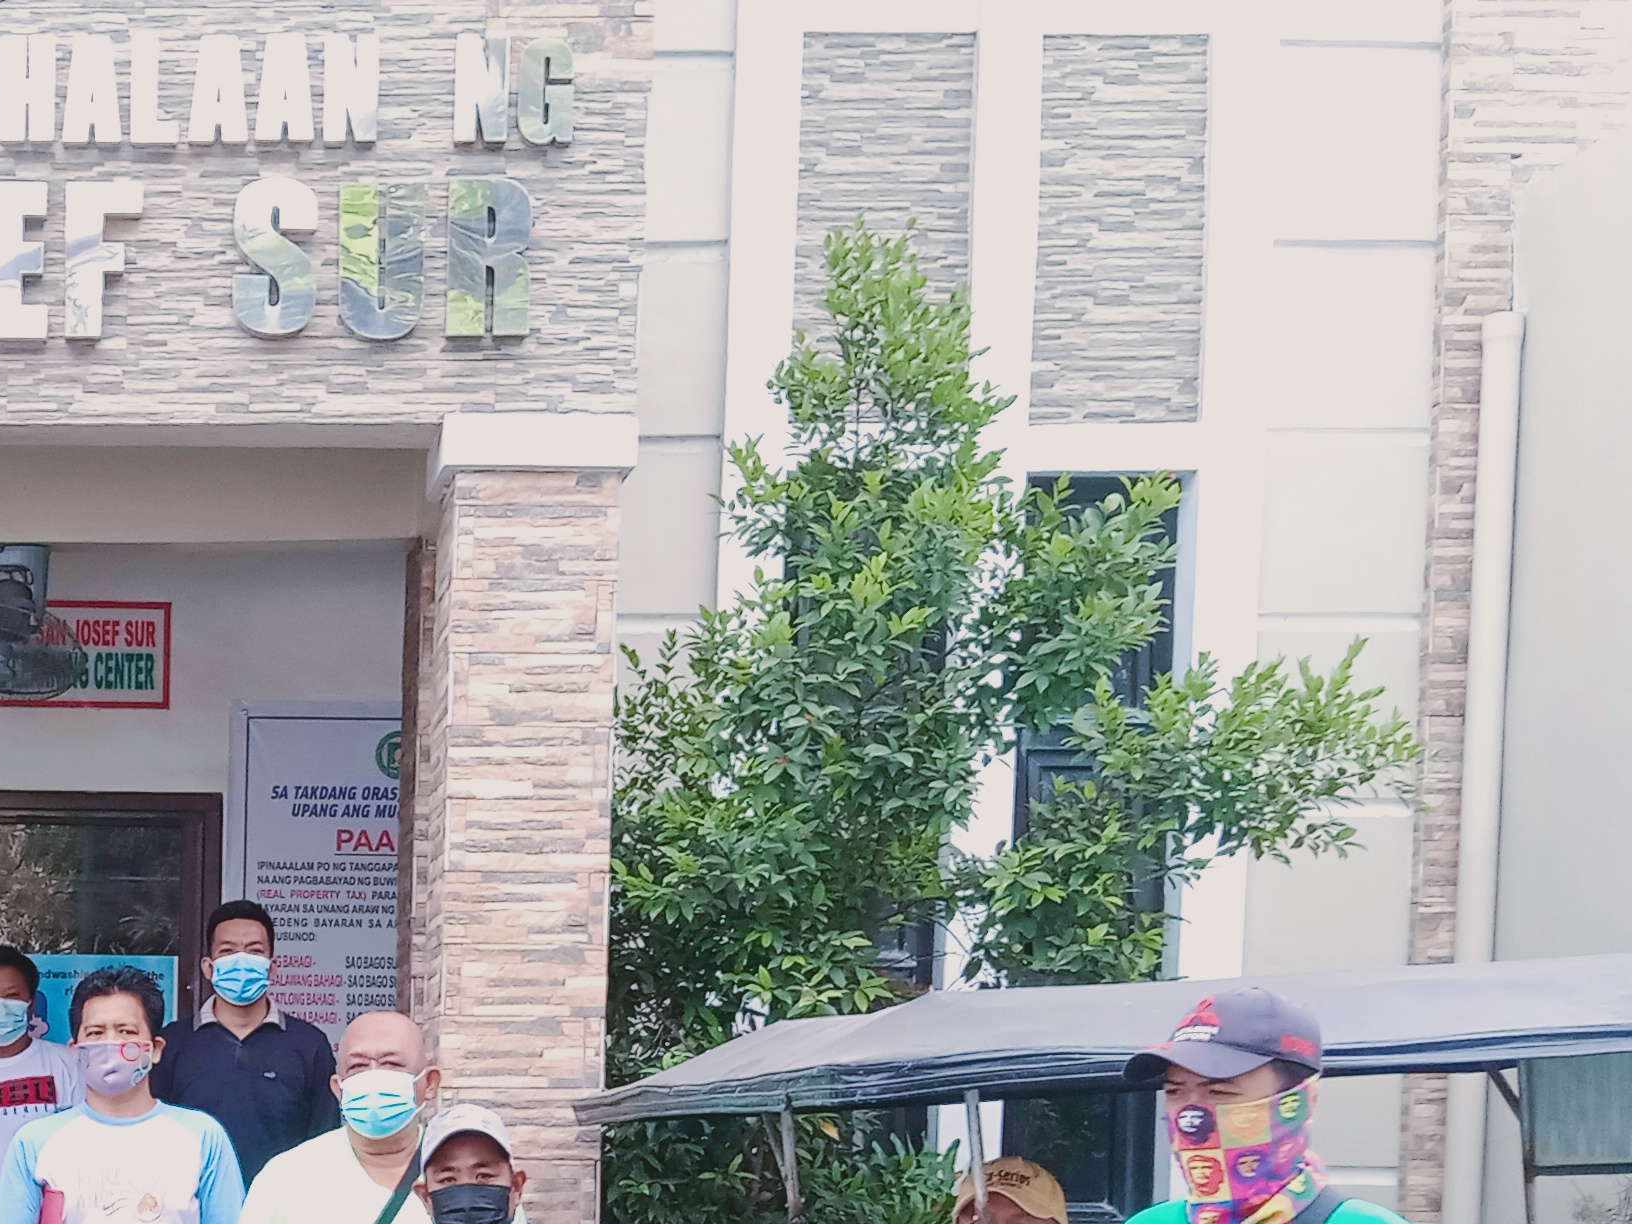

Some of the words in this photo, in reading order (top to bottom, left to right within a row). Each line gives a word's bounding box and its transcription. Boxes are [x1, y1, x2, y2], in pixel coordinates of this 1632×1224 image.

[454, 36, 574, 146] NG
[232, 176, 531, 341] SUR
[76, 620, 120, 647] JOSEF
[124, 619, 156, 648] SUR
[94, 652, 155, 690] CENTER
[270, 785, 289, 800] SA
[293, 785, 358, 800] TAKDANG
[291, 803, 339, 818] UPANG
[341, 804, 371, 818] ANG
[336, 829, 396, 852] PAA
[317, 862, 331, 871] PO
[332, 862, 347, 872] NG
[293, 876, 356, 886] PAGBABAYAD
[357, 876, 371, 886] NG
[257, 889, 285, 900] (REAL
[290, 889, 340, 899] PROPERTY
[346, 889, 367, 901] TAX)
[371, 890, 398, 900] PARA
[262, 903, 300, 913] AYARAN
[302, 904, 315, 914] SA
[317, 904, 349, 914] UNANG
[351, 904, 380, 914] ARAW
[381, 905, 395, 915] NG
[272, 917, 308, 927] EDENG
[314, 918, 363, 928] BAYARAN
[367, 918, 382, 928] SA
[275, 931, 317, 942] USUNOD:
